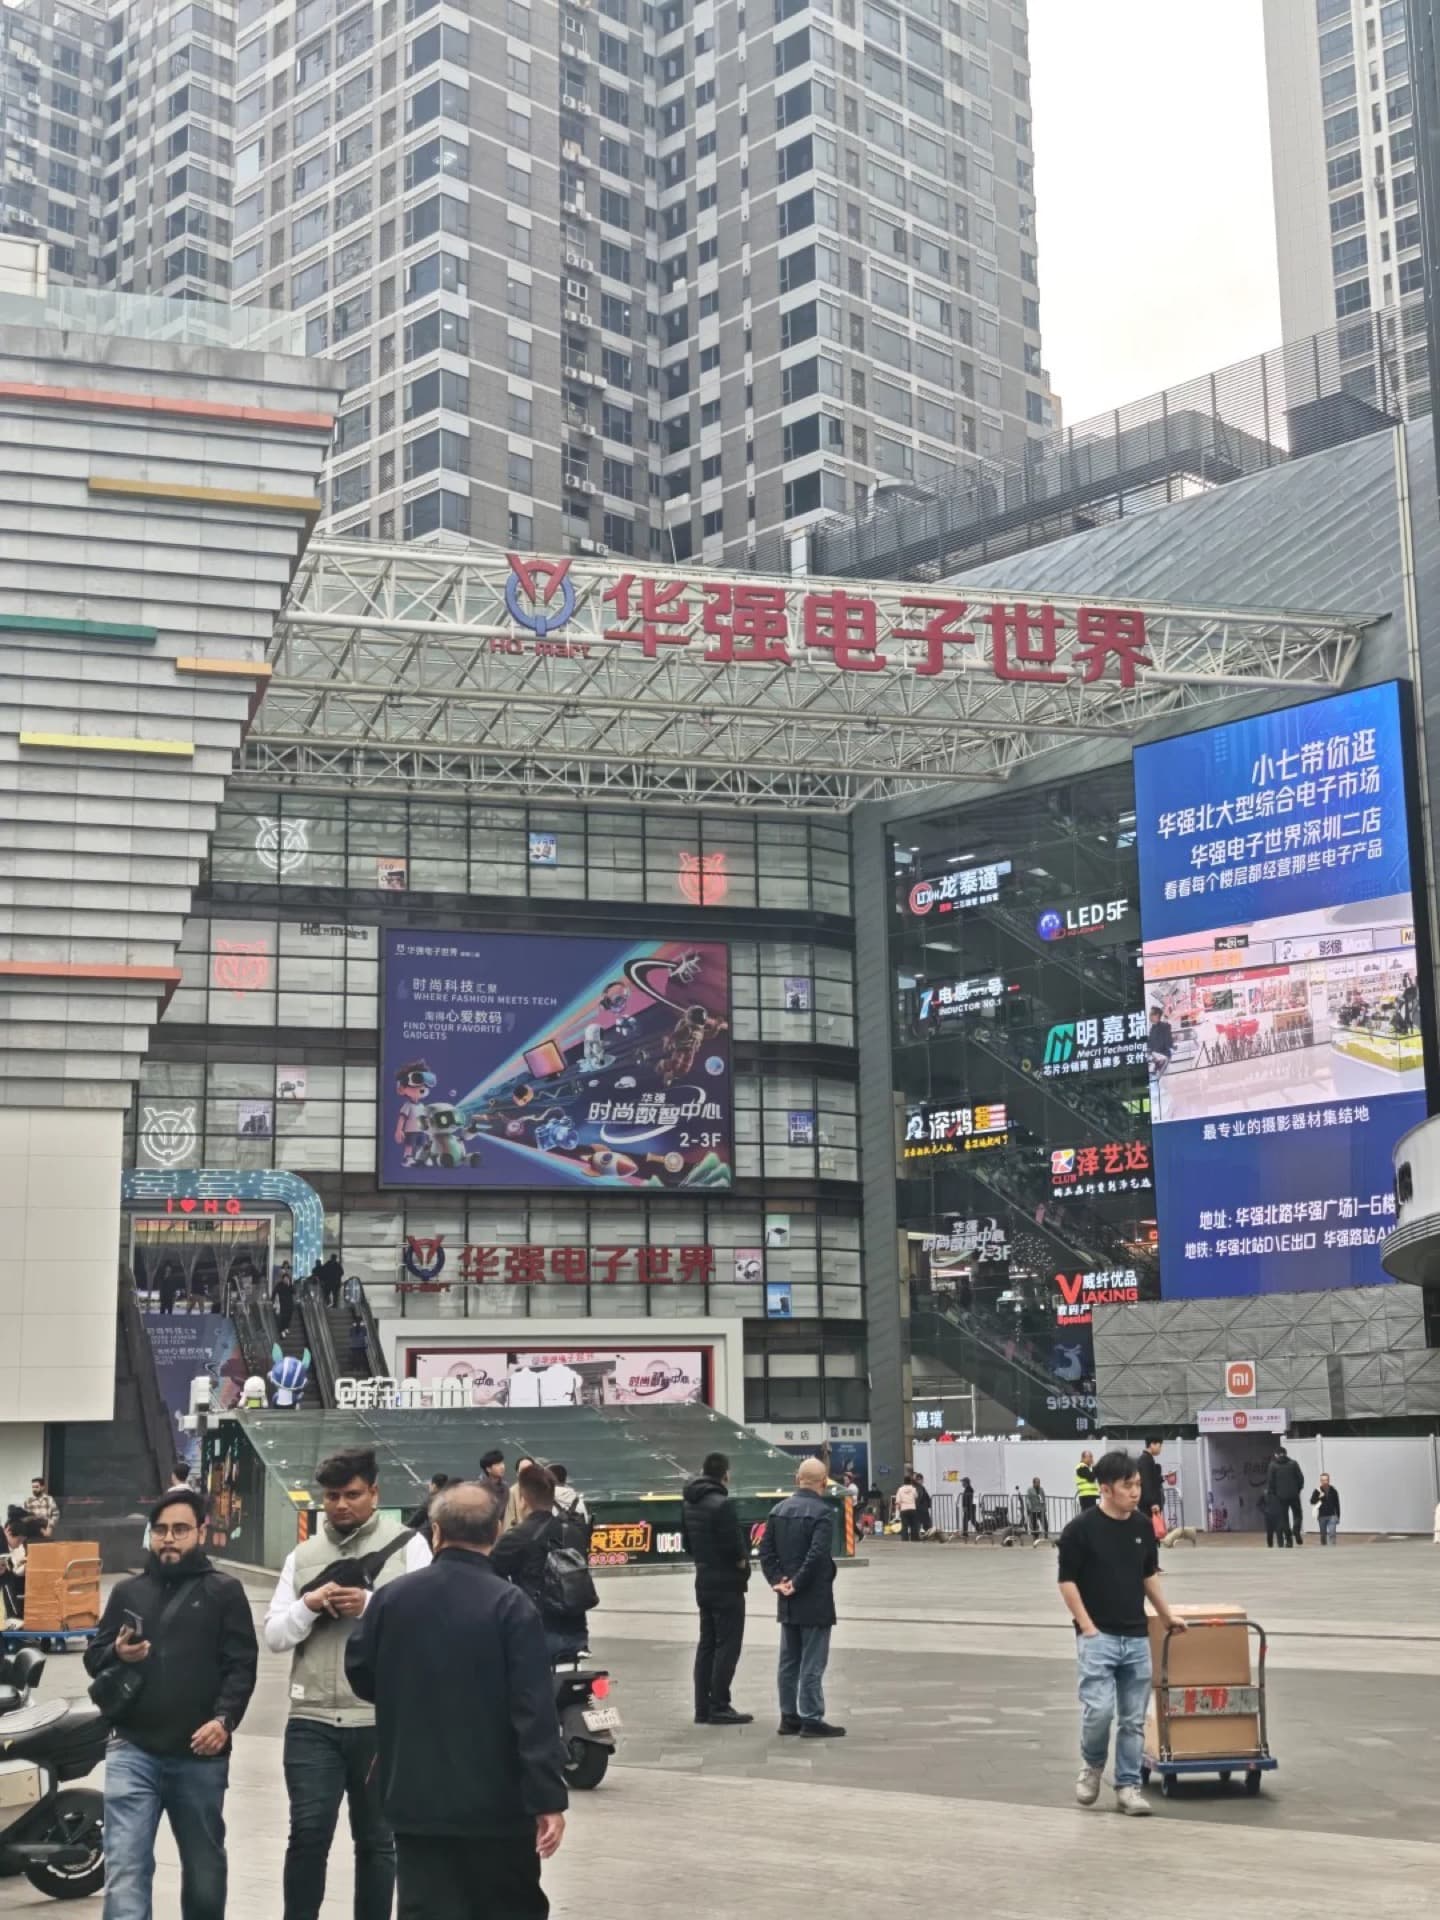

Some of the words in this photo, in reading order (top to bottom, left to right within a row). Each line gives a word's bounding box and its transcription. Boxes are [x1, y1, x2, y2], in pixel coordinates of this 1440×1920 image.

[603, 573, 1153, 688] 华强电子世界
[1251, 728, 1376, 786] 小七带你逛
[1156, 765, 1381, 840] 华强北大型综合电子市场
[1189, 806, 1382, 869] 华强电子世界深圳二店
[1164, 839, 1383, 901] 看看每个楼层都经营那些电子产品
[1066, 903, 1104, 929] LED
[1106, 899, 1128, 921] 5F
[413, 993, 448, 1001] WHERE
[451, 994, 495, 1004] FASHION
[497, 996, 529, 1005] MEETS
[532, 997, 557, 1006] TECH
[403, 1021, 426, 1030] FIND
[428, 1022, 453, 1032] YOUR
[456, 1024, 502, 1034] FAVORITE
[403, 1031, 447, 1041] GADGETS
[1076, 1010, 1146, 1048] 明嘉瑞
[587, 1098, 723, 1125] 时尚数智中心
[642, 1092, 666, 1103] 华强
[679, 1132, 722, 1148] 2-3F
[1203, 1105, 1370, 1140] 最专业的摄影器材集结地
[1077, 1140, 1149, 1176] 泽艺达
[458, 1246, 716, 1284] 华强电子世界
